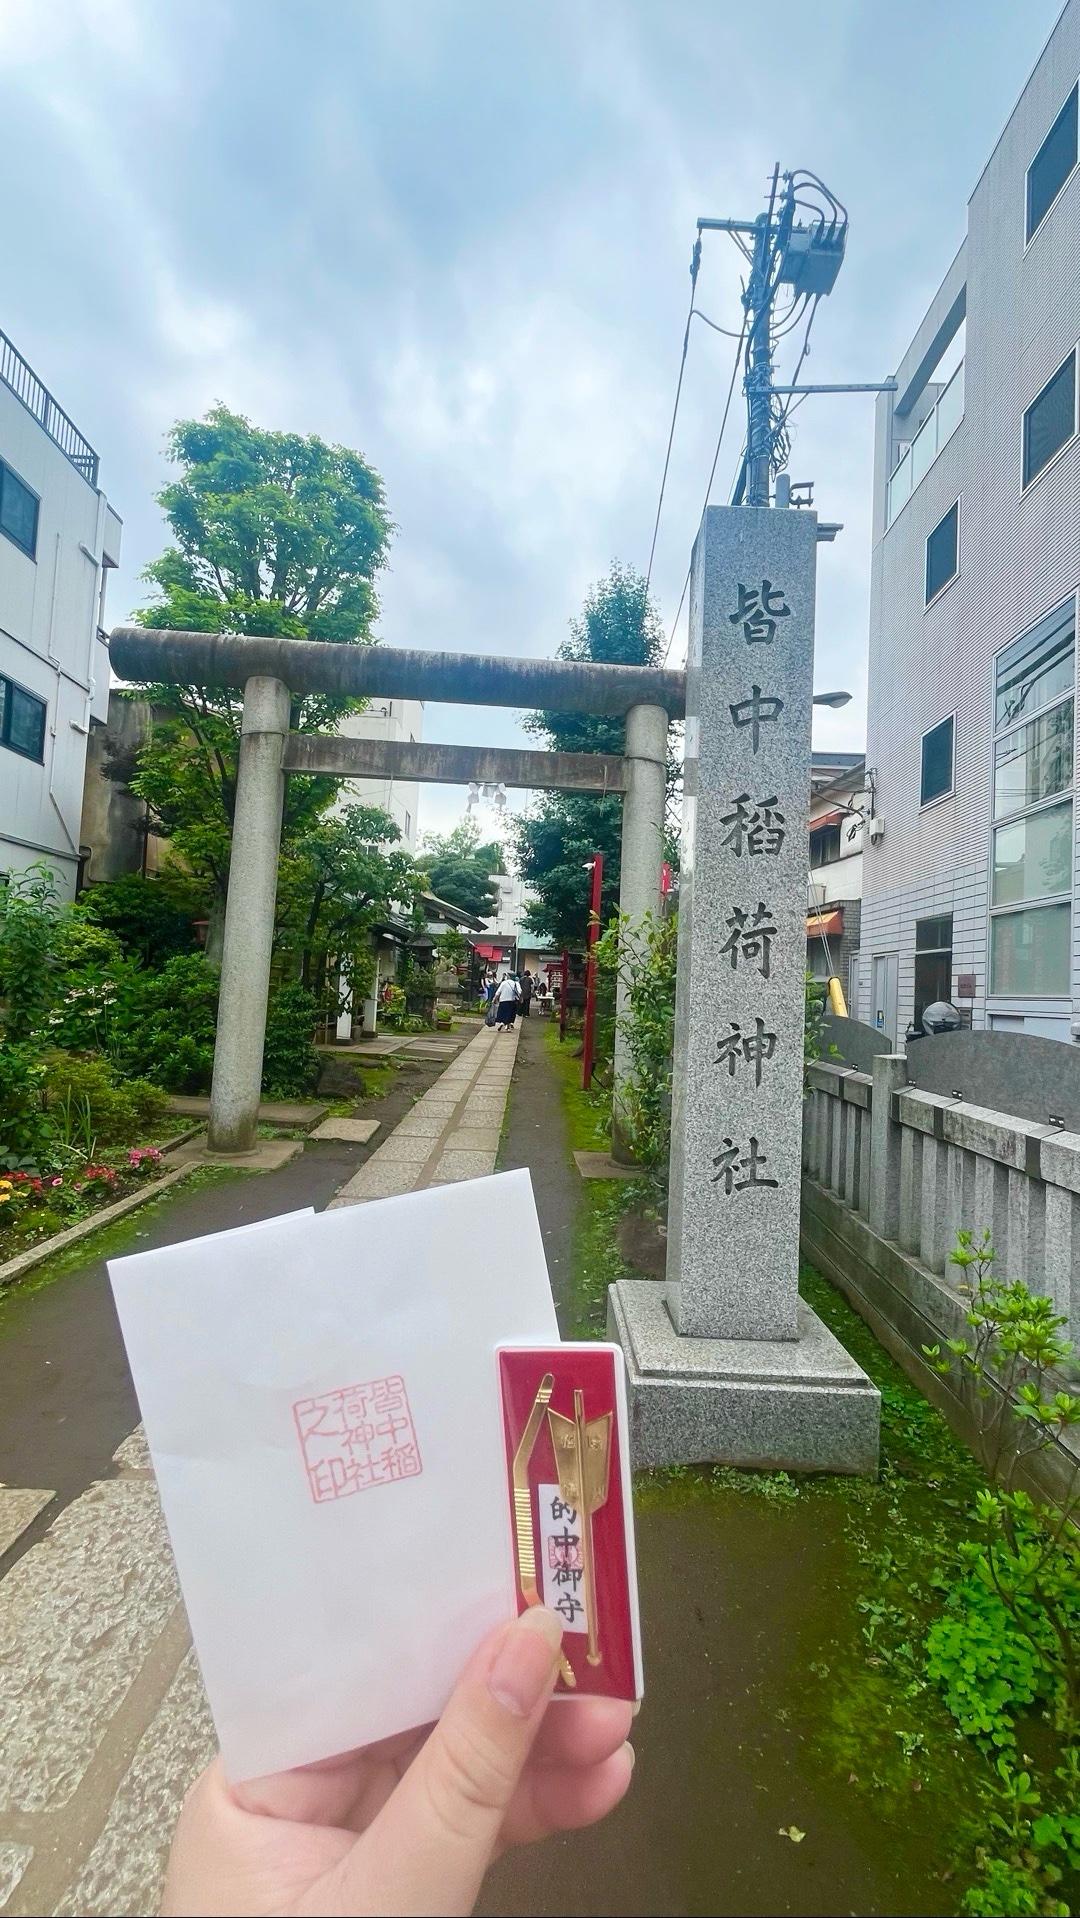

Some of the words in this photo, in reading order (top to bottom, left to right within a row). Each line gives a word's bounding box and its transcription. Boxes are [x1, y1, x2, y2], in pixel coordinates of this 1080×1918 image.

[712, 580, 791, 1197] 皆中稲荷神社
[550, 1495, 584, 1623] 的中御守
